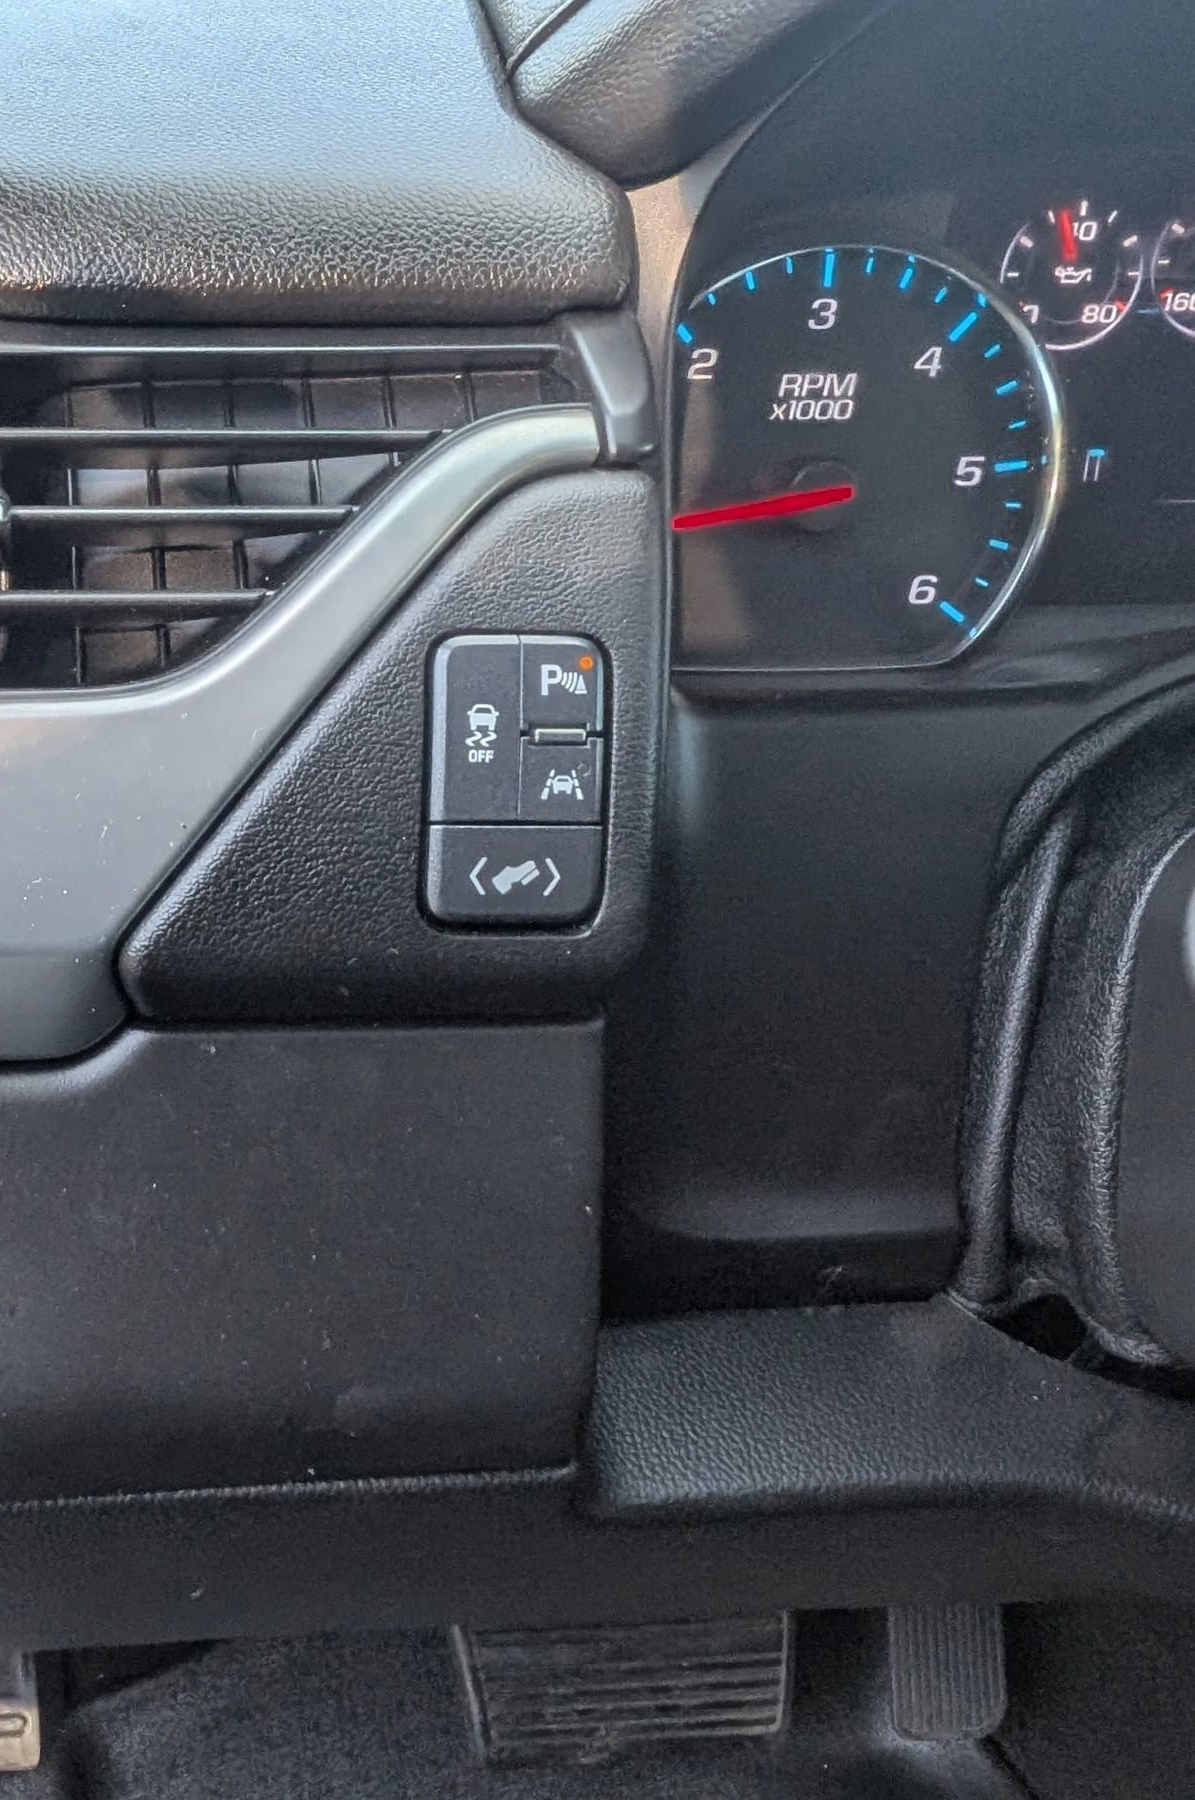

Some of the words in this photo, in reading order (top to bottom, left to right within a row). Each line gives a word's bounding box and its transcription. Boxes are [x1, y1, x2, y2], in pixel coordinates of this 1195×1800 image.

[807, 298, 838, 330] 3
[1081, 304, 1118, 324] 80
[687, 348, 718, 380] 2
[913, 346, 943, 377] 4
[778, 372, 858, 397] RPM
[769, 399, 855, 421] x1000
[954, 455, 986, 487] 5
[908, 574, 939, 604] 6
[468, 749, 495, 763] OFF
